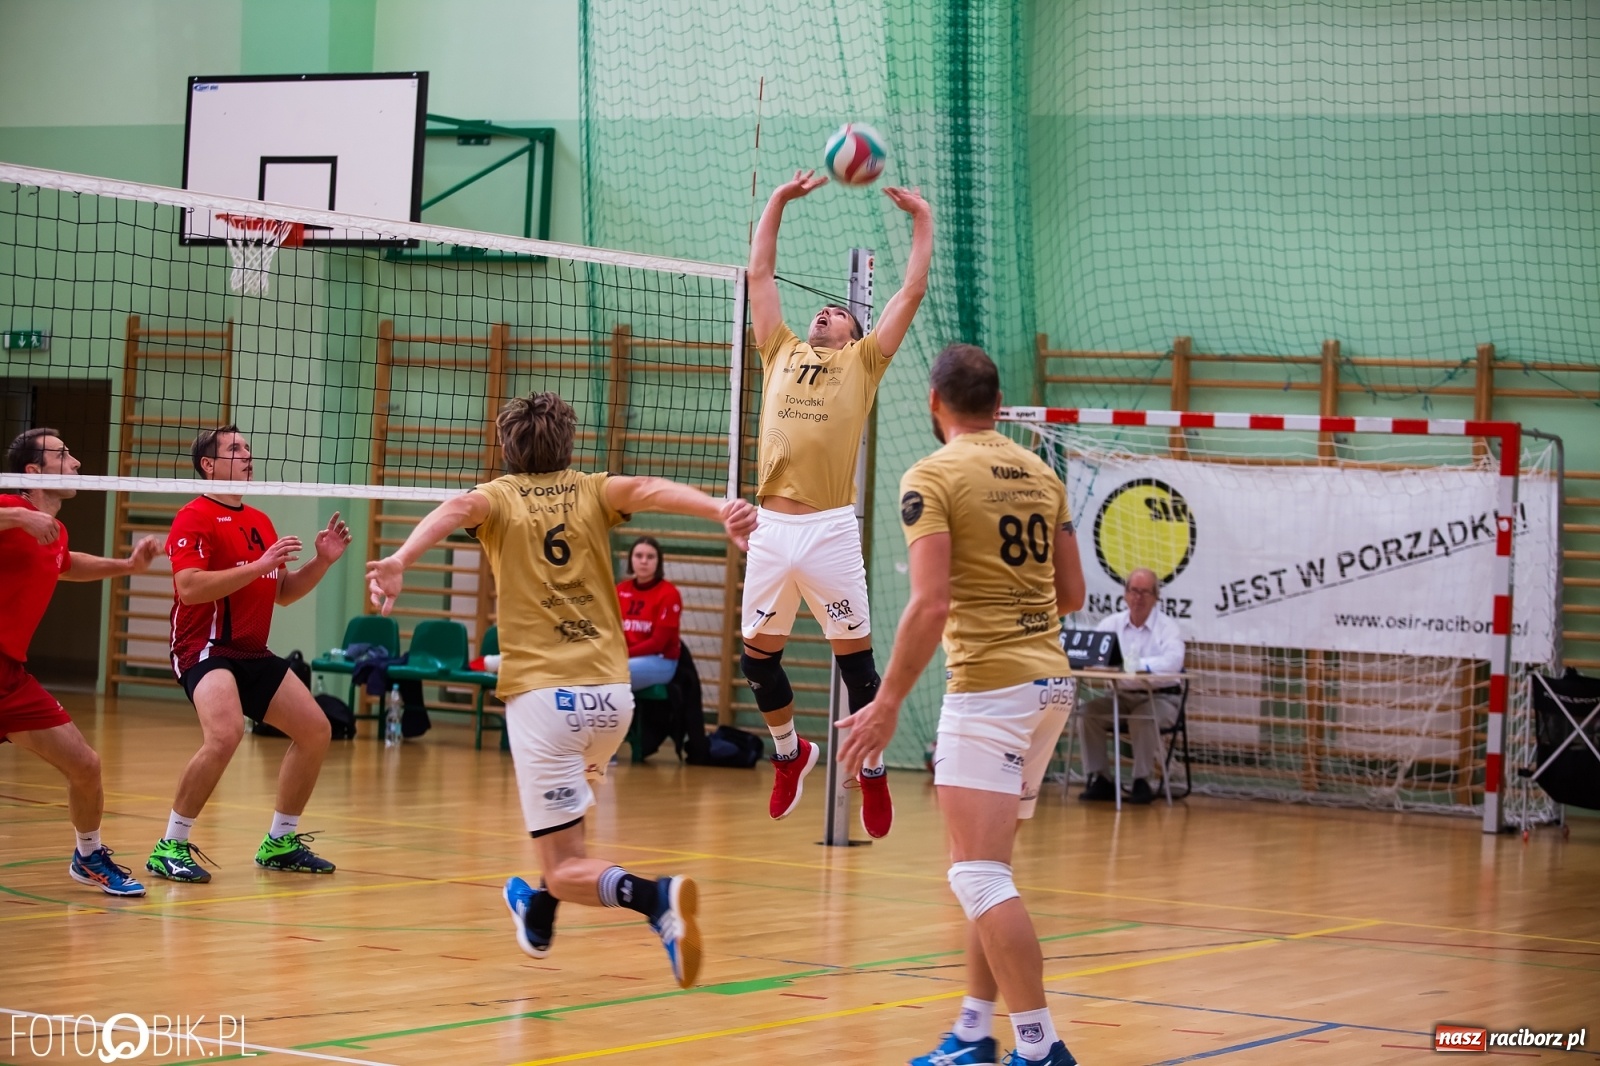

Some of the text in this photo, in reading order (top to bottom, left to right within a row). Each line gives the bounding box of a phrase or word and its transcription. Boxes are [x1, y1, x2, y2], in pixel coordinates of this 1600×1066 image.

[797, 364, 823, 385] 77
[785, 394, 825, 406] Towalski
[239, 526, 266, 551] 14
[543, 523, 571, 567] 6
[999, 513, 1050, 567] 80
[1214, 569, 1288, 612] JEST
[1296, 557, 1326, 588] W
[824, 599, 850, 613] ZOO
[579, 693, 617, 712] DK
[566, 712, 619, 733] glass
